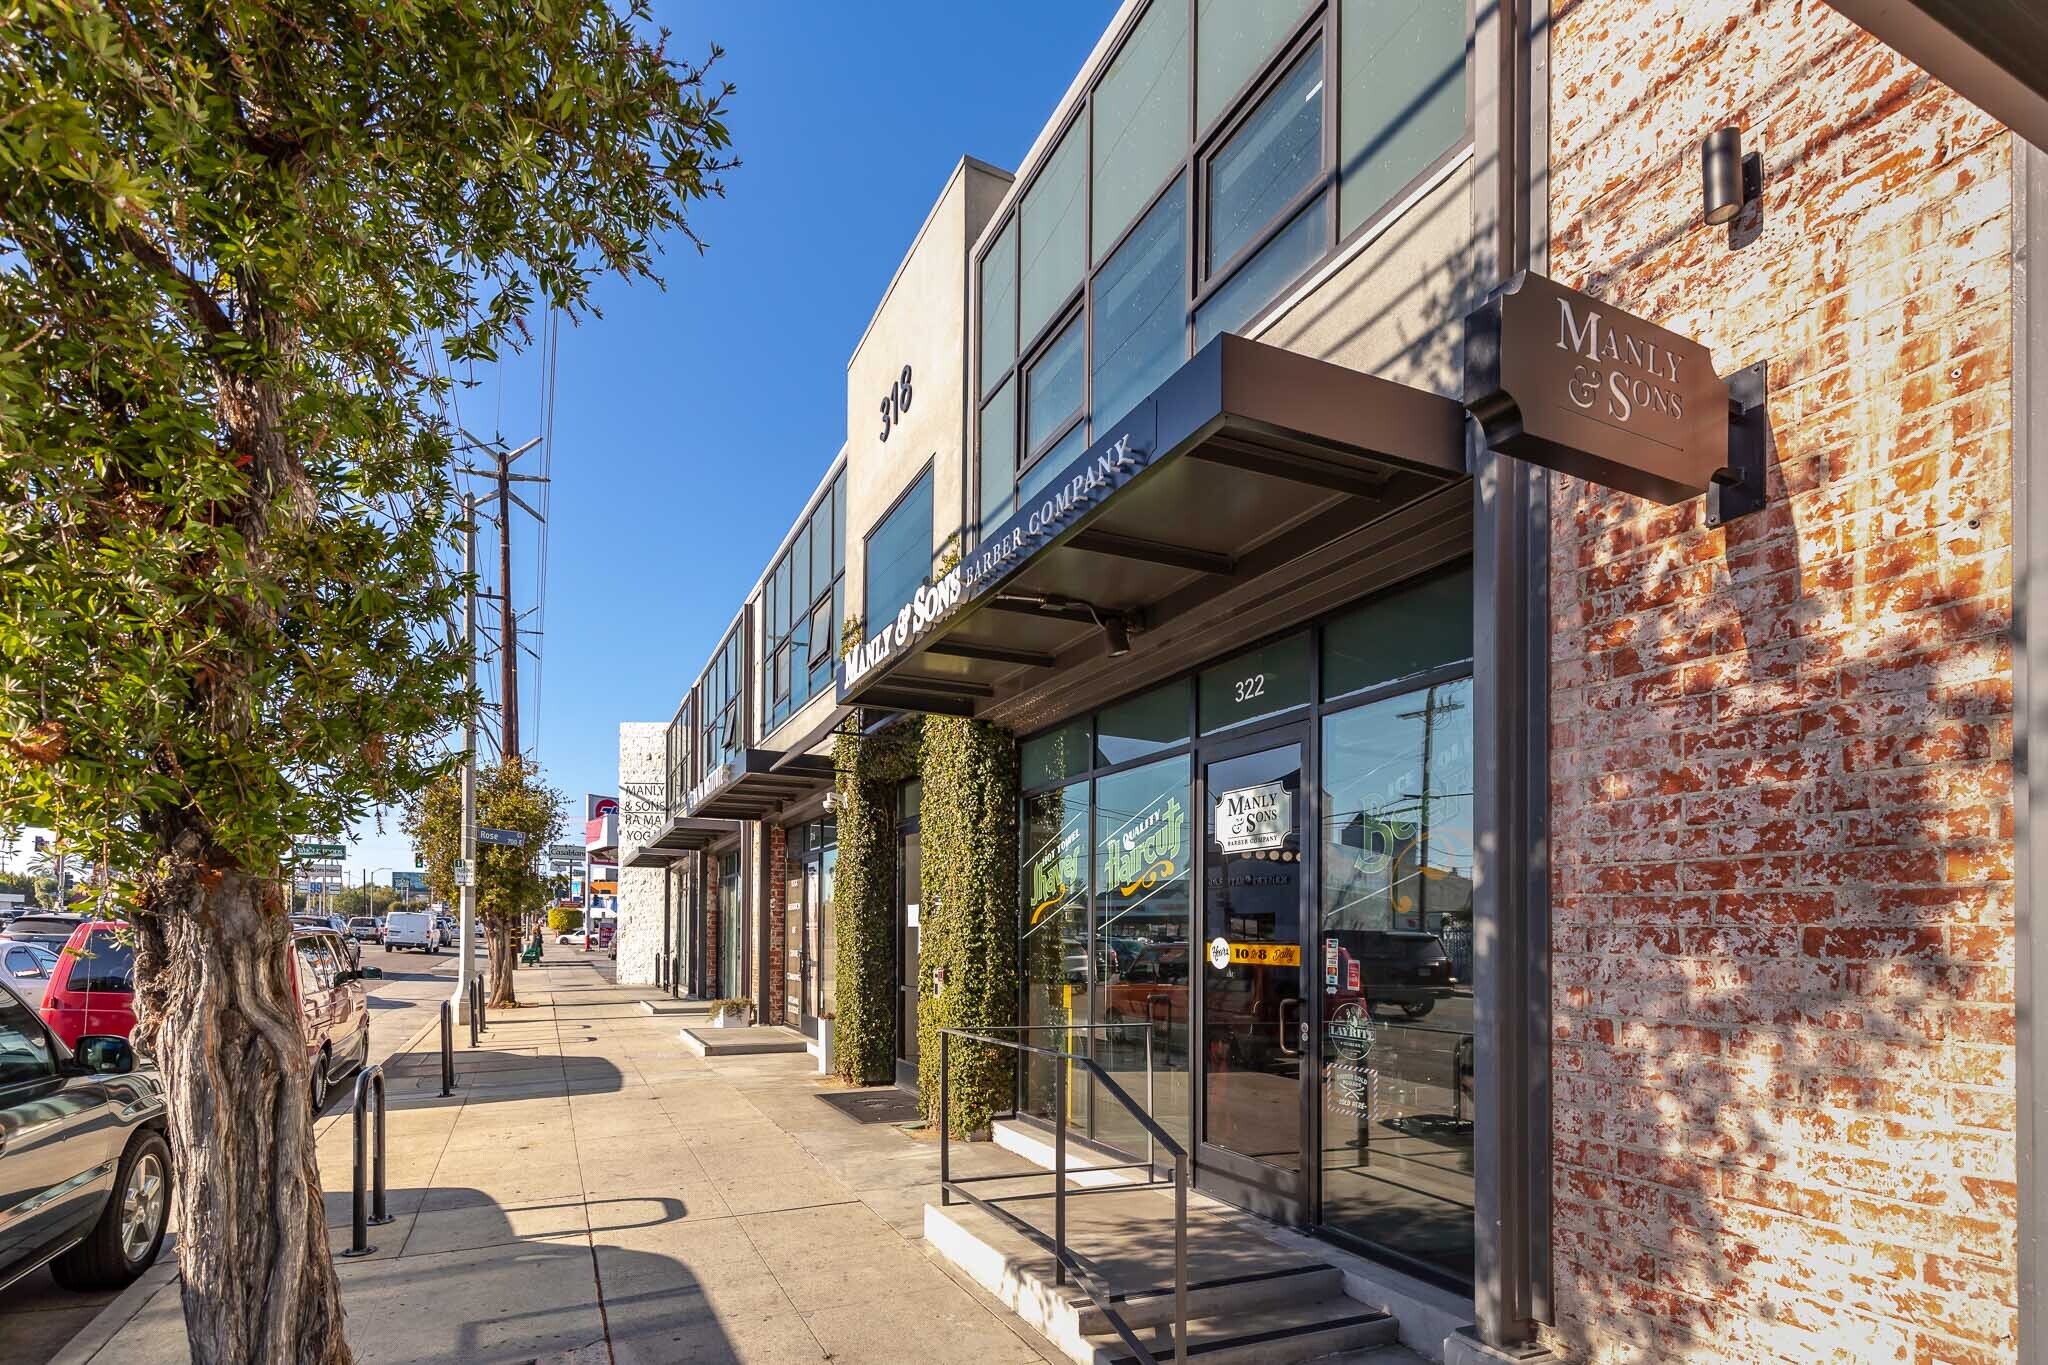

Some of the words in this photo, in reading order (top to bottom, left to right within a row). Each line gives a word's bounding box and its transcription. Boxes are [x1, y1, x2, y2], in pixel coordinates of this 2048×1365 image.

[1556, 297, 1684, 384] MANLY
[879, 364, 912, 443] 318
[1568, 365, 1602, 408] &
[1608, 371, 1683, 422] SONS
[844, 624, 893, 690] MANLY
[895, 603, 911, 646] &
[913, 565, 961, 634] SONS
[965, 527, 1023, 587] BARBER
[1029, 433, 1135, 536] COMPANY
[1235, 674, 1265, 702] 322
[626, 785, 665, 796] MANLY
[624, 801, 632, 811] &
[635, 800, 666, 811] SONS
[1228, 793, 1277, 816] MANLY
[625, 815, 640, 825] RA
[1123, 809, 1161, 850] QUALITY
[1232, 818, 1244, 834] &
[1246, 810, 1277, 832] SONS
[480, 831, 499, 840] Rose
[627, 830, 656, 841] YOG
[1042, 849, 1055, 867] HOT
[1057, 828, 1081, 855] TOWEL
[1104, 797, 1184, 893] Haircuts
[1228, 837, 1249, 847] BARBER
[1249, 835, 1278, 845] COMPANY
[1030, 845, 1081, 907] Shaves
[1235, 948, 1249, 960] 10
[1258, 948, 1268, 960] 8
[1330, 1024, 1376, 1042] LAYRITE
